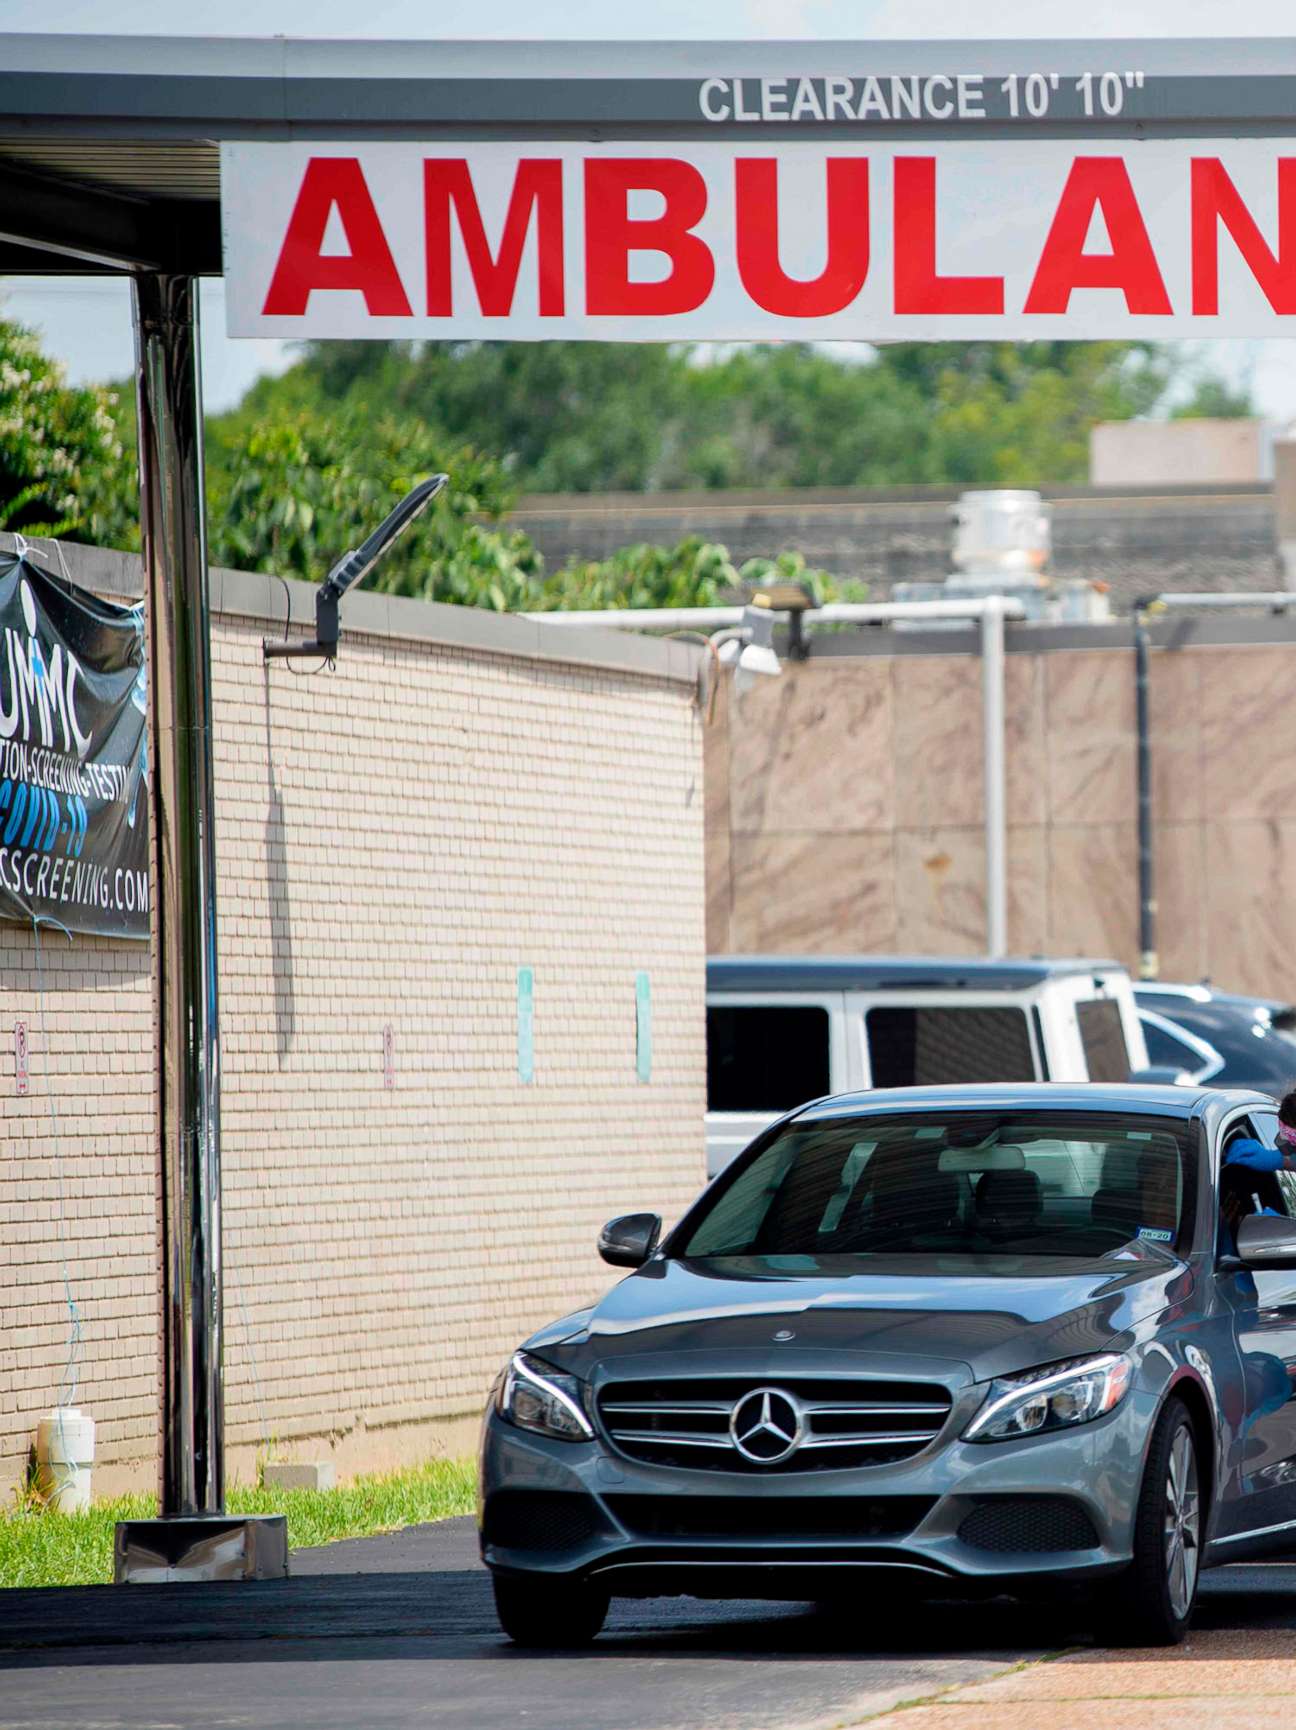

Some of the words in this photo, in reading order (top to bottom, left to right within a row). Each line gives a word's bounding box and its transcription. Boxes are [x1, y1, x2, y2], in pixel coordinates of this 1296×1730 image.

[699, 73, 986, 122] CLEARANCE
[1001, 73, 1058, 118] 10'
[1075, 71, 1144, 116] 10"
[0, 847, 149, 913] CSCREENING.COM
